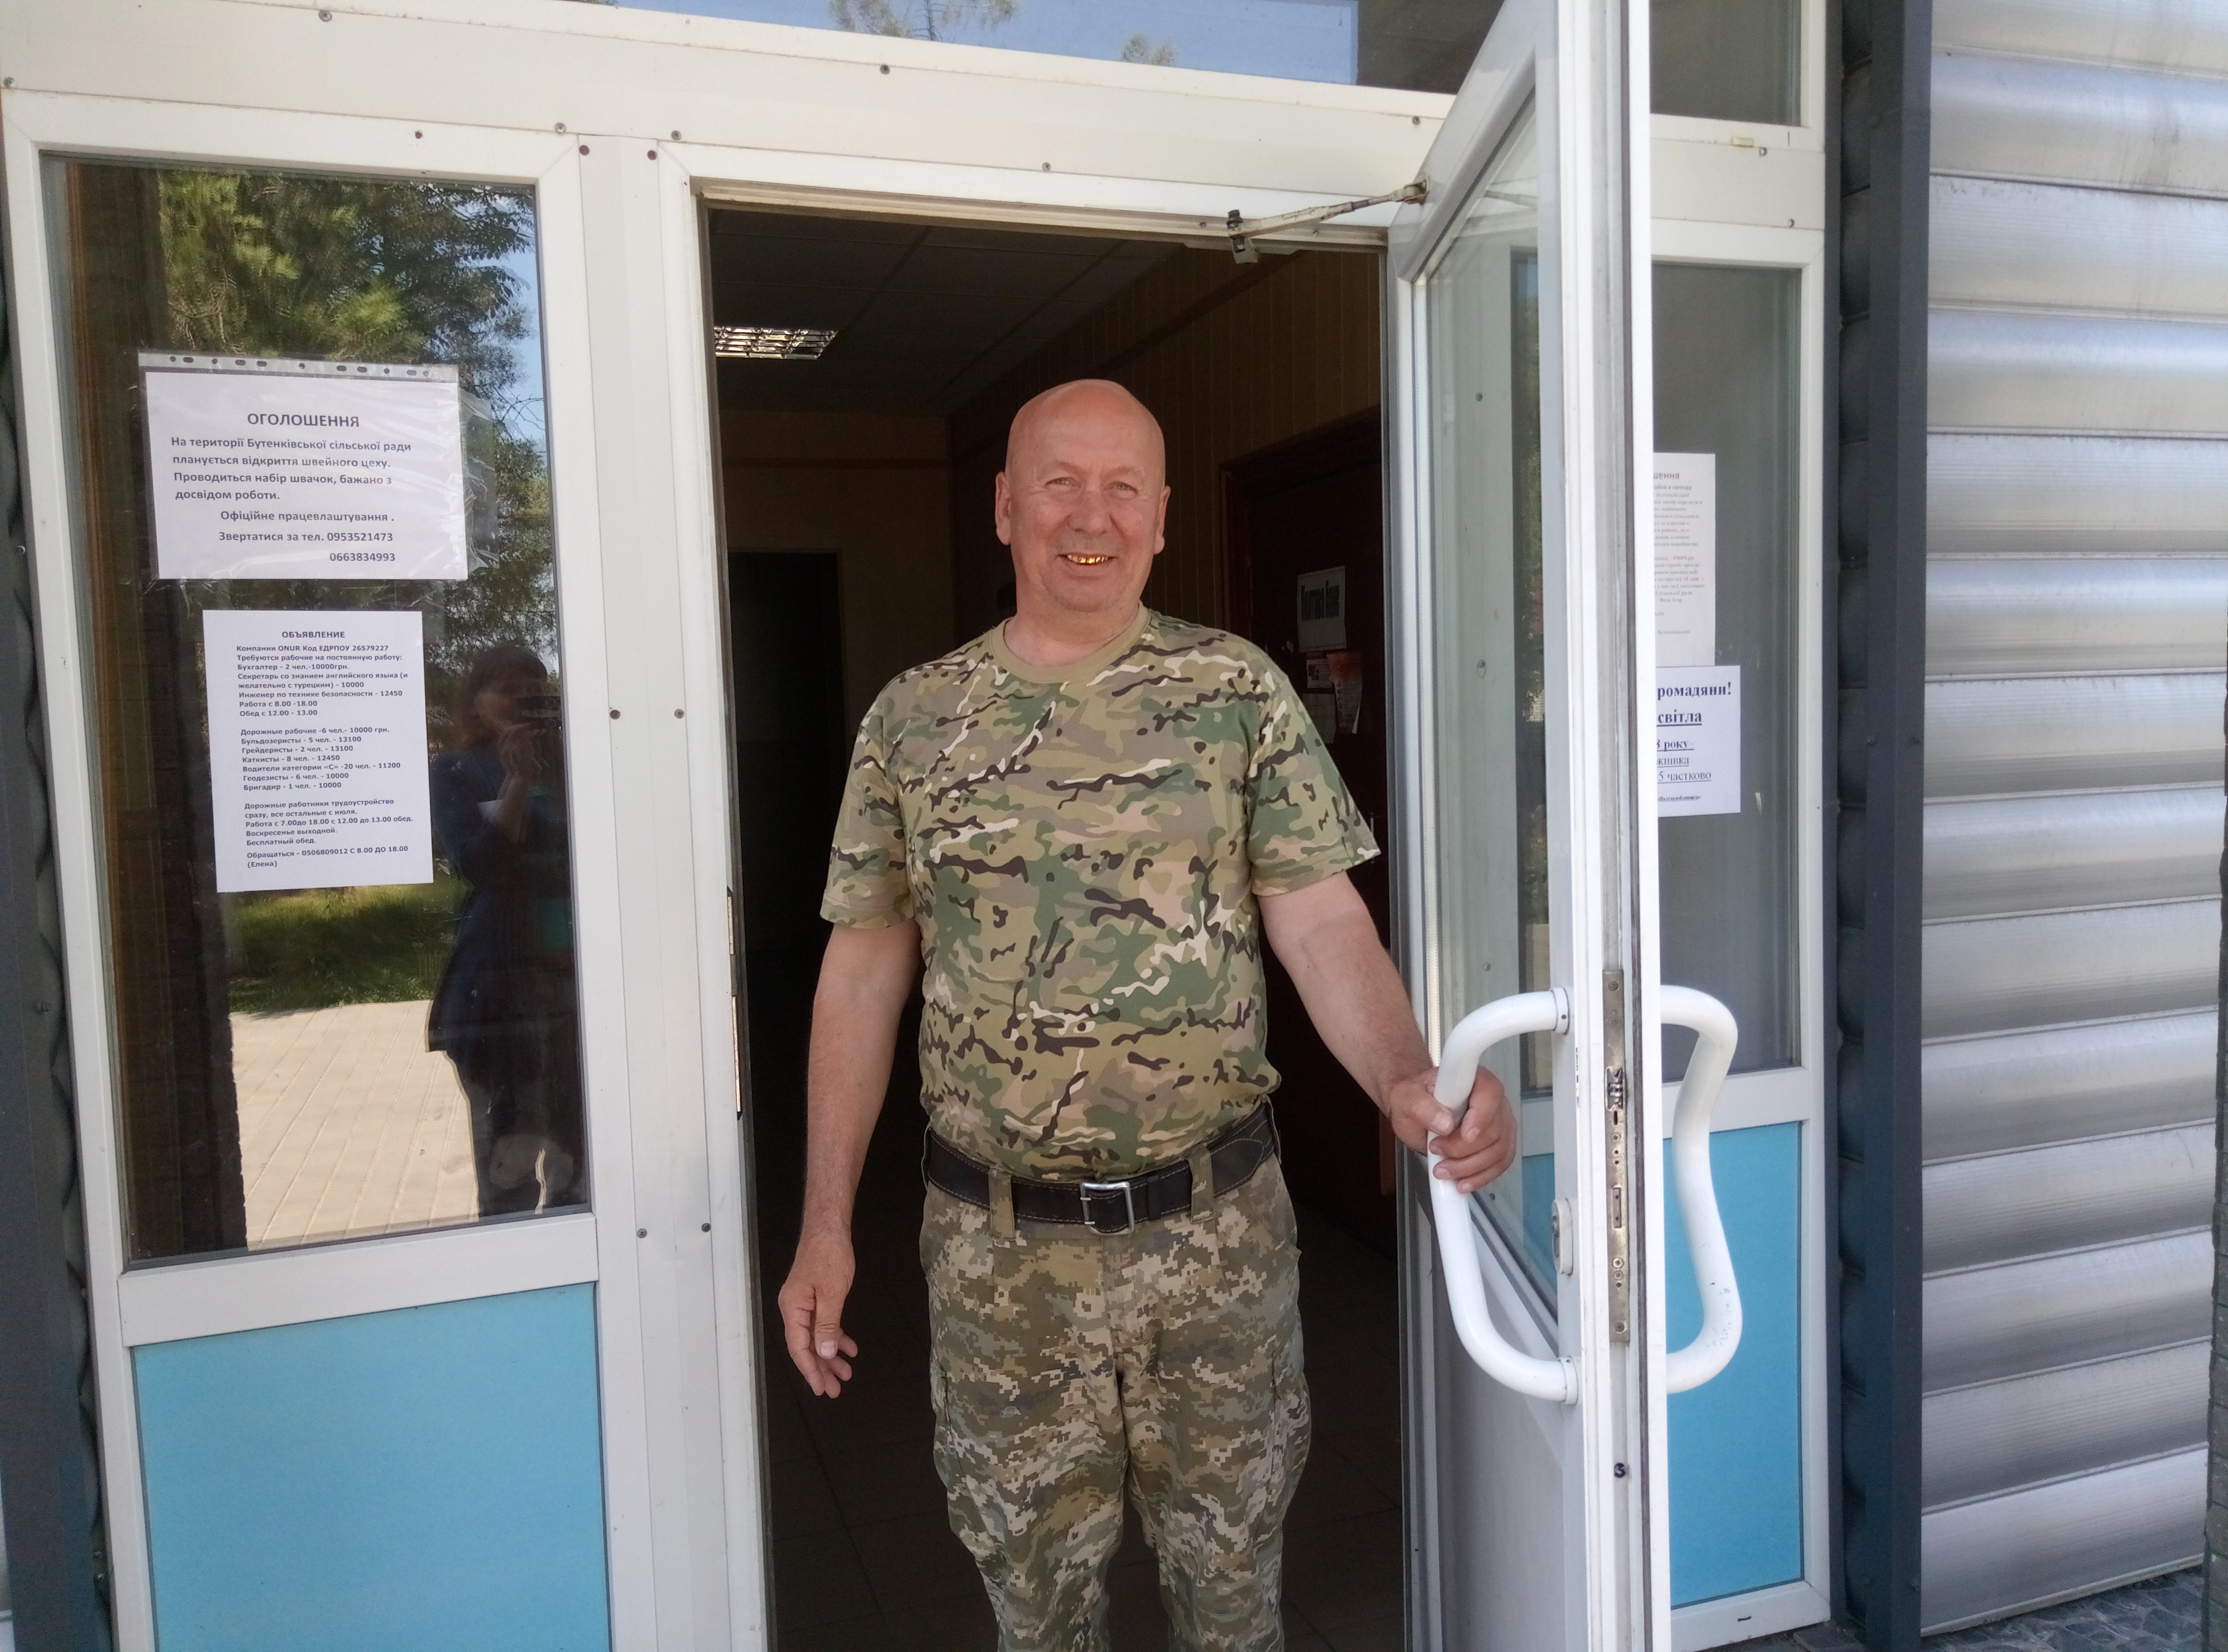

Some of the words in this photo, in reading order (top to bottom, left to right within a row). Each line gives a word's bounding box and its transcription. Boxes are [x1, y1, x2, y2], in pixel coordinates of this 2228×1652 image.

[247, 413, 359, 427] ОГОЛОШЕННЯ
[171, 436, 186, 446] На
[189, 438, 244, 449] території
[247, 438, 326, 450] Бутенківської
[329, 440, 380, 450] сільської
[383, 444, 410, 452] ради
[173, 456, 238, 466] планується
[242, 455, 298, 467] відкриття
[302, 457, 358, 466] швейного
[361, 460, 390, 469] цеху.
[174, 472, 251, 483] Проводиться
[255, 473, 286, 484] набір
[290, 476, 336, 484] швачок,
[339, 474, 383, 484] бажано
[175, 489, 231, 500] досвідом
[235, 490, 280, 501] роботи.
[220, 510, 275, 522] Офіційне
[278, 514, 388, 523] працевлаштування
[219, 532, 283, 543] Звертатися
[327, 532, 393, 541] 0953521473
[329, 552, 396, 561] 0663834993
[1657, 681, 1731, 701] ромадяни!
[1658, 709, 1702, 724] світла
[1657, 755, 1689, 766] жнівка
[1667, 772, 1711, 782] частково
[331, 798, 394, 807] трудоустройство
